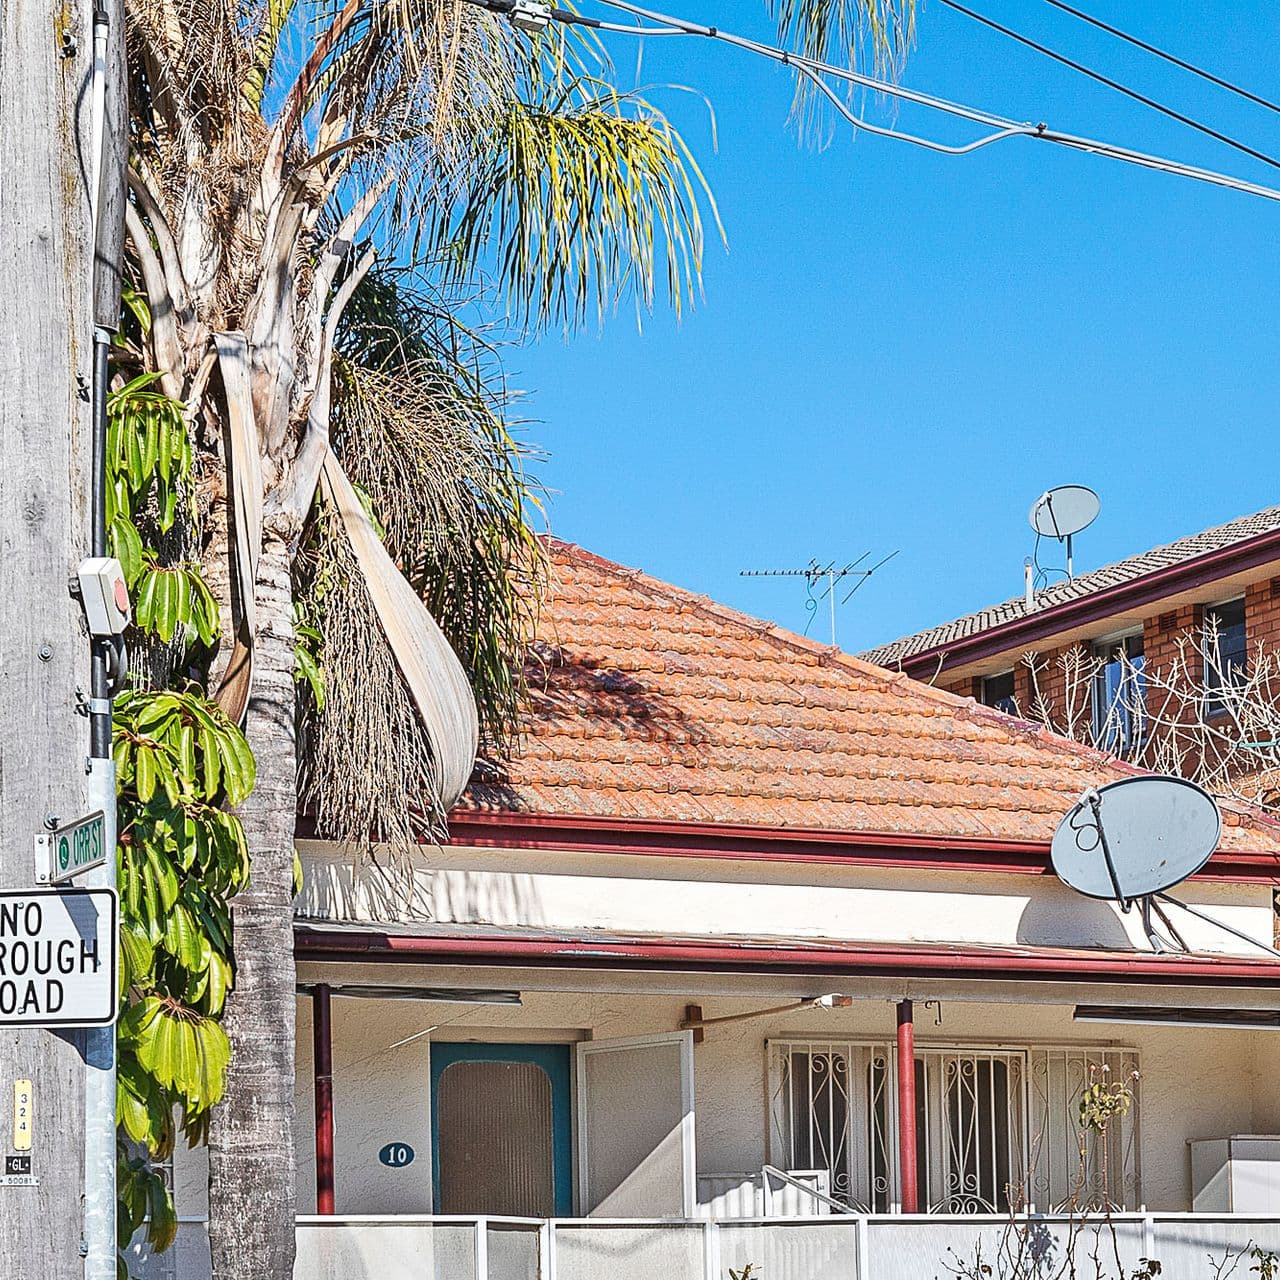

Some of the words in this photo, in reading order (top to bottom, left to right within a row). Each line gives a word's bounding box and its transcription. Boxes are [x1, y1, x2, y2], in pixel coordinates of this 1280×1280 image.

[73, 825, 91, 866] ORR
[91, 820, 102, 859] ST
[0, 901, 43, 937] NO
[11, 1158, 26, 1171] GL
[388, 1146, 407, 1163] 10
